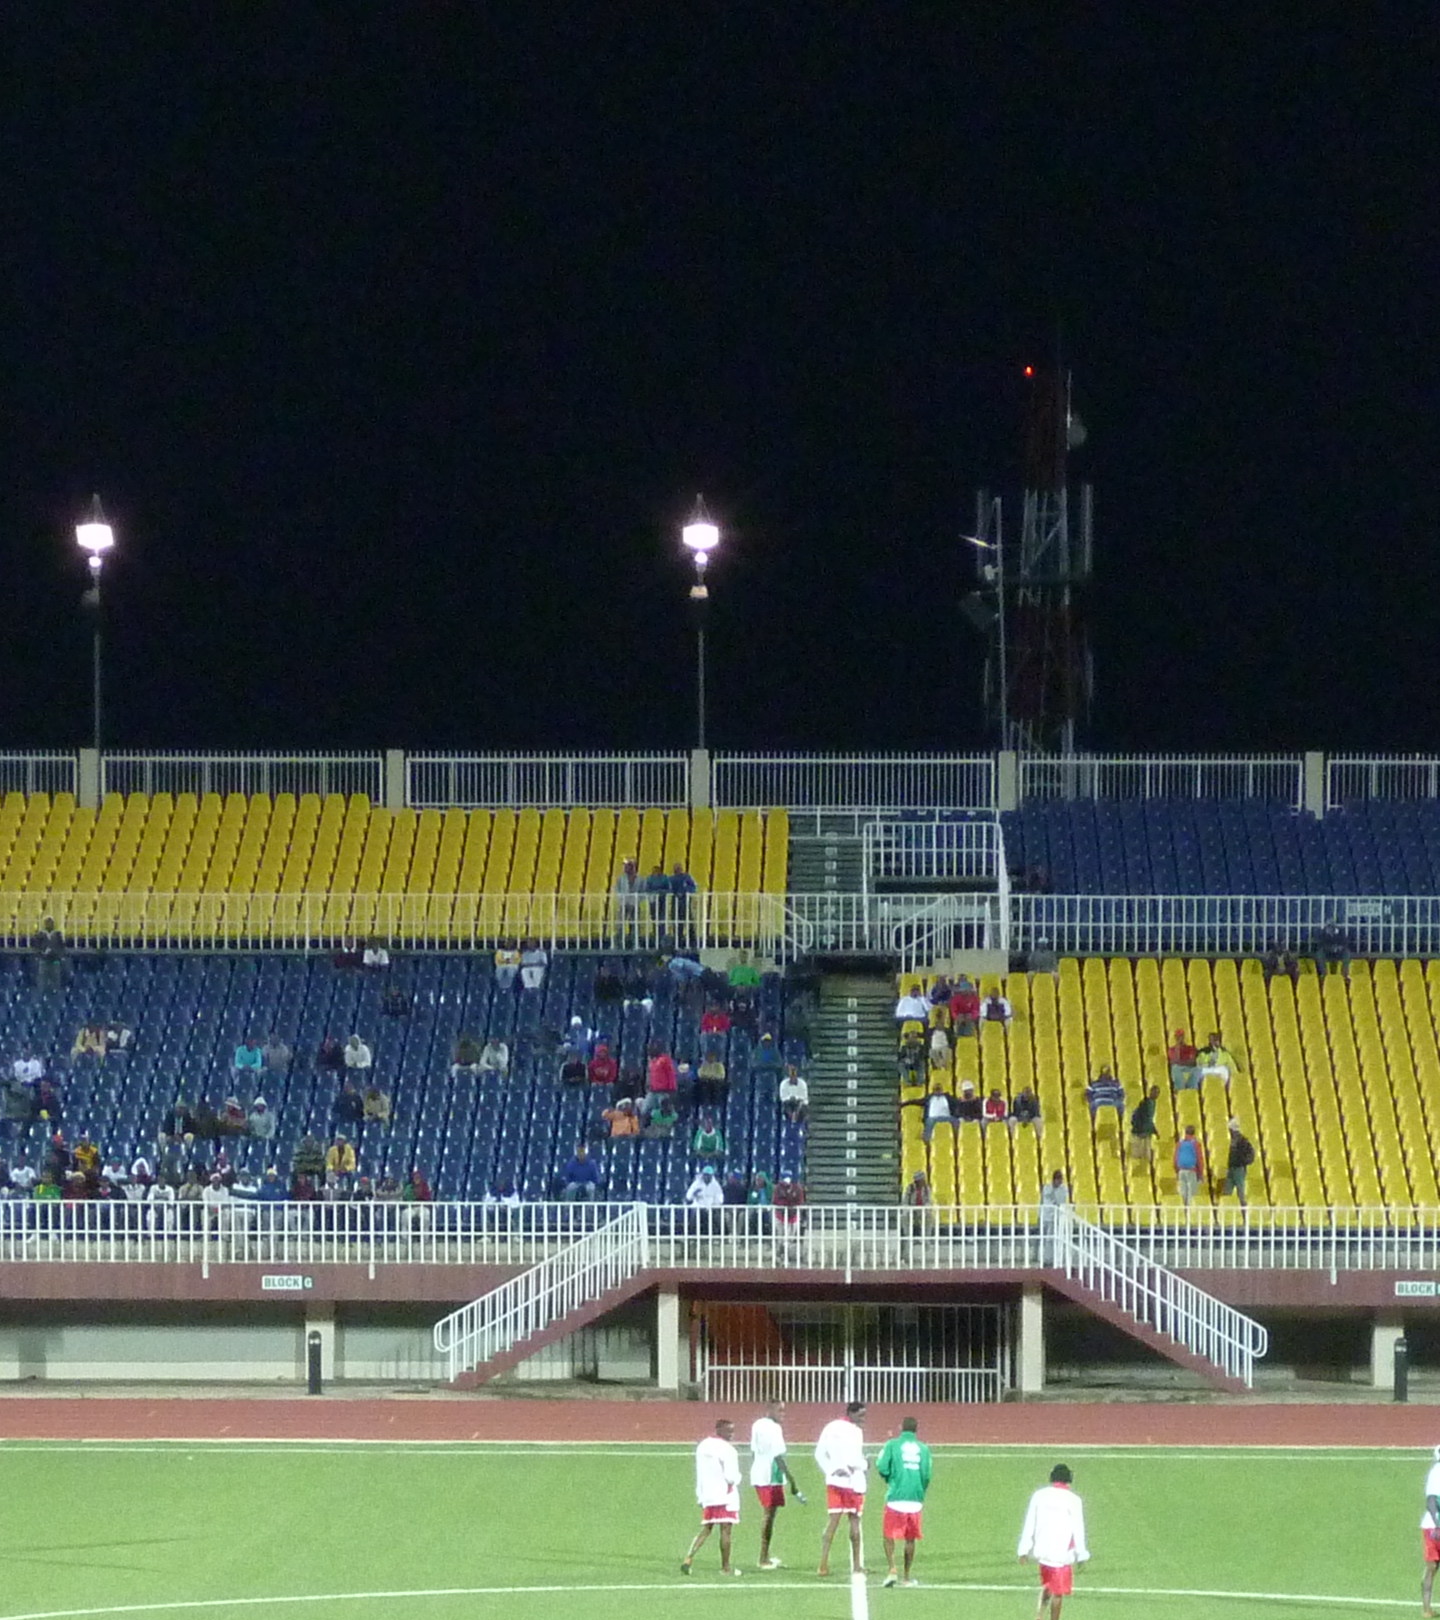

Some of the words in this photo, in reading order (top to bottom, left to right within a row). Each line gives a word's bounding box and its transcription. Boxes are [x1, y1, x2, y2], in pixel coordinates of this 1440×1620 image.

[1347, 904, 1380, 915] BLOCK
[264, 1277, 300, 1288] BLOCK
[304, 1276, 313, 1289] G
[1397, 1283, 1433, 1294] BLOCK
